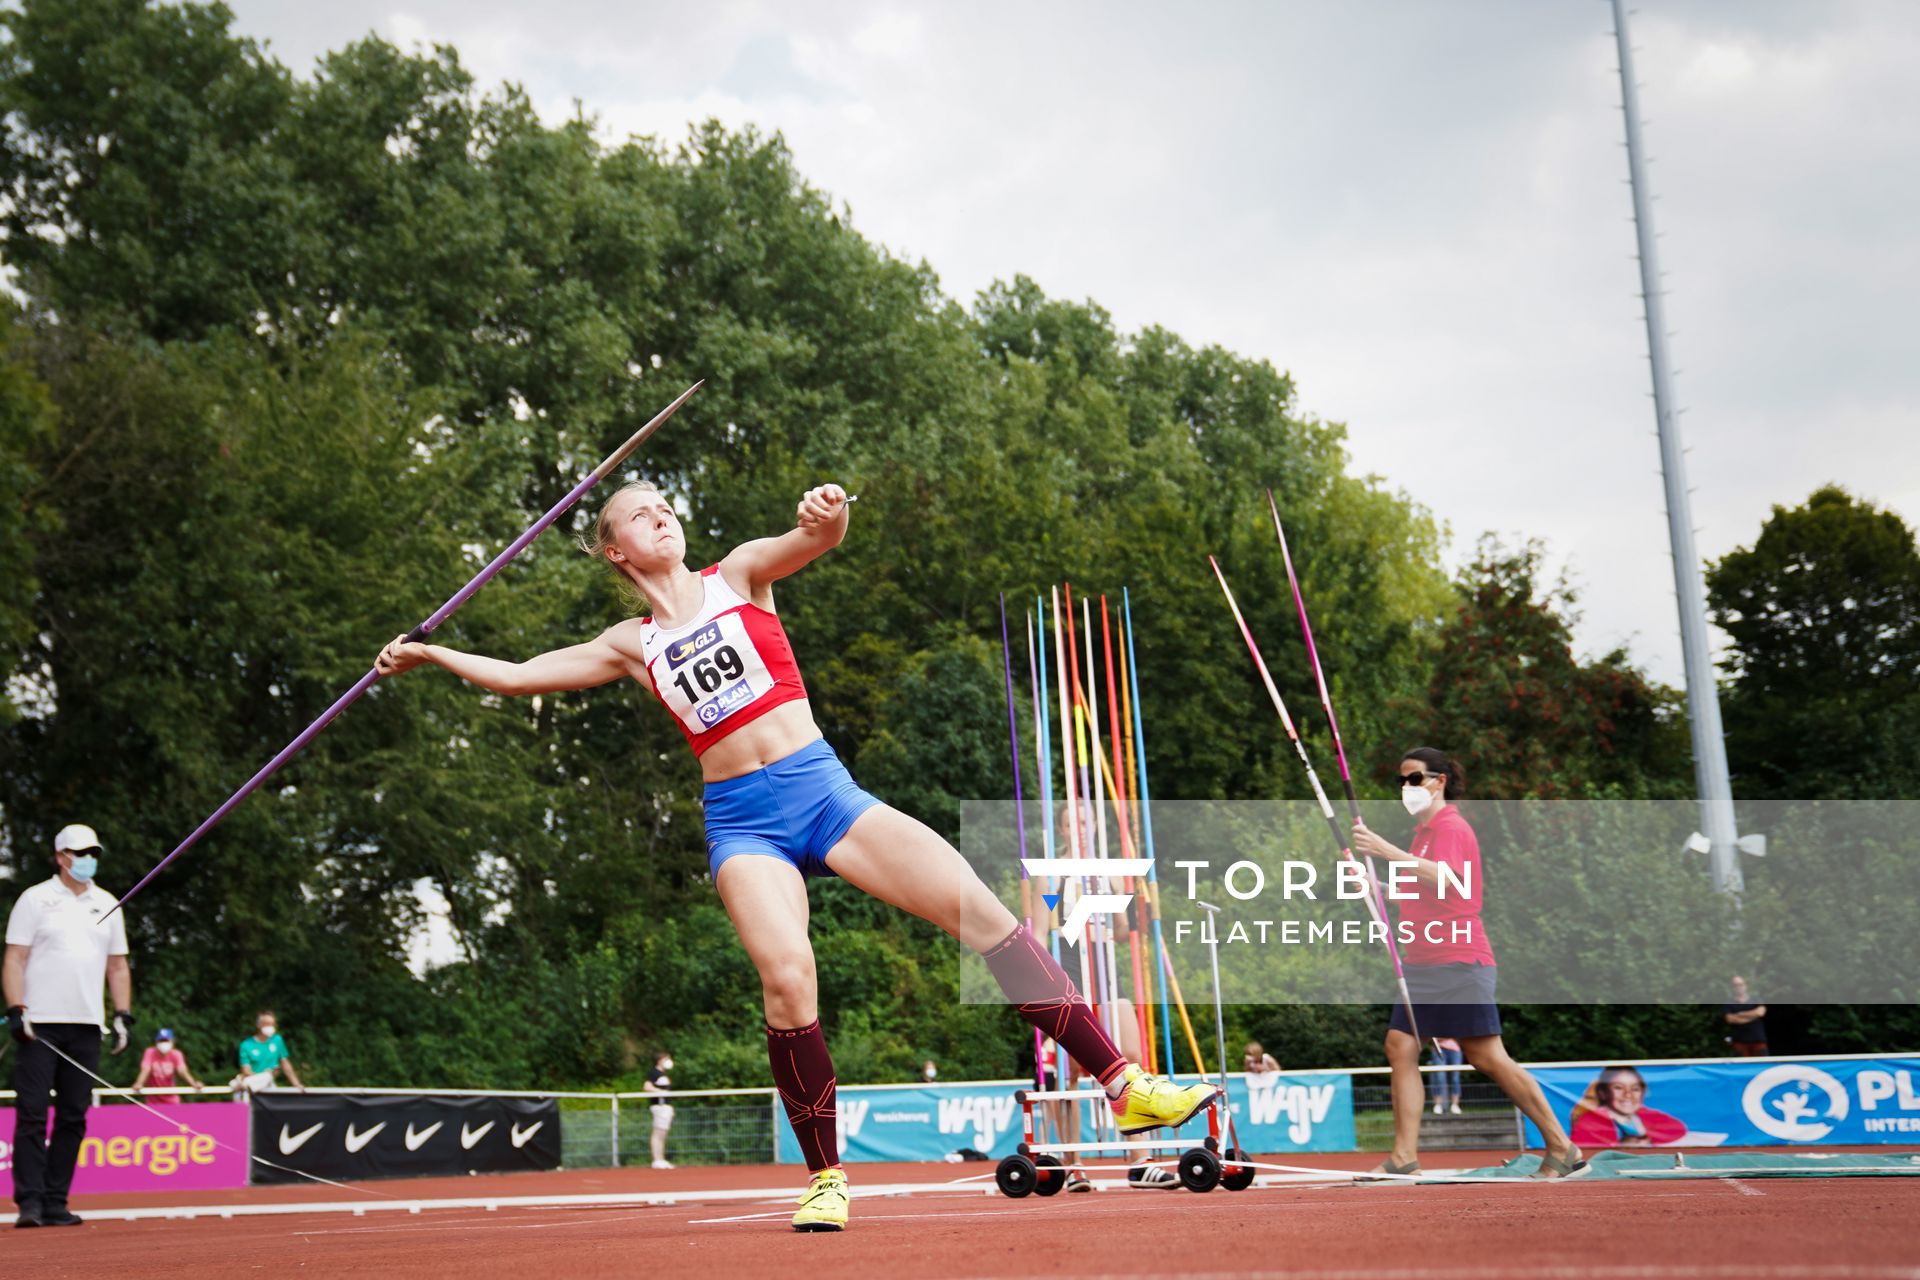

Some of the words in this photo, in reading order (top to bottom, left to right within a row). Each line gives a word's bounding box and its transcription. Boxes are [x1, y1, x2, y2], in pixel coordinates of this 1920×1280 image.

[695, 628, 716, 649] GLS
[674, 645, 744, 704] 169
[717, 684, 750, 709] PLAN
[77, 1123, 217, 1175] nergie
[816, 1182, 840, 1193] NIKE
